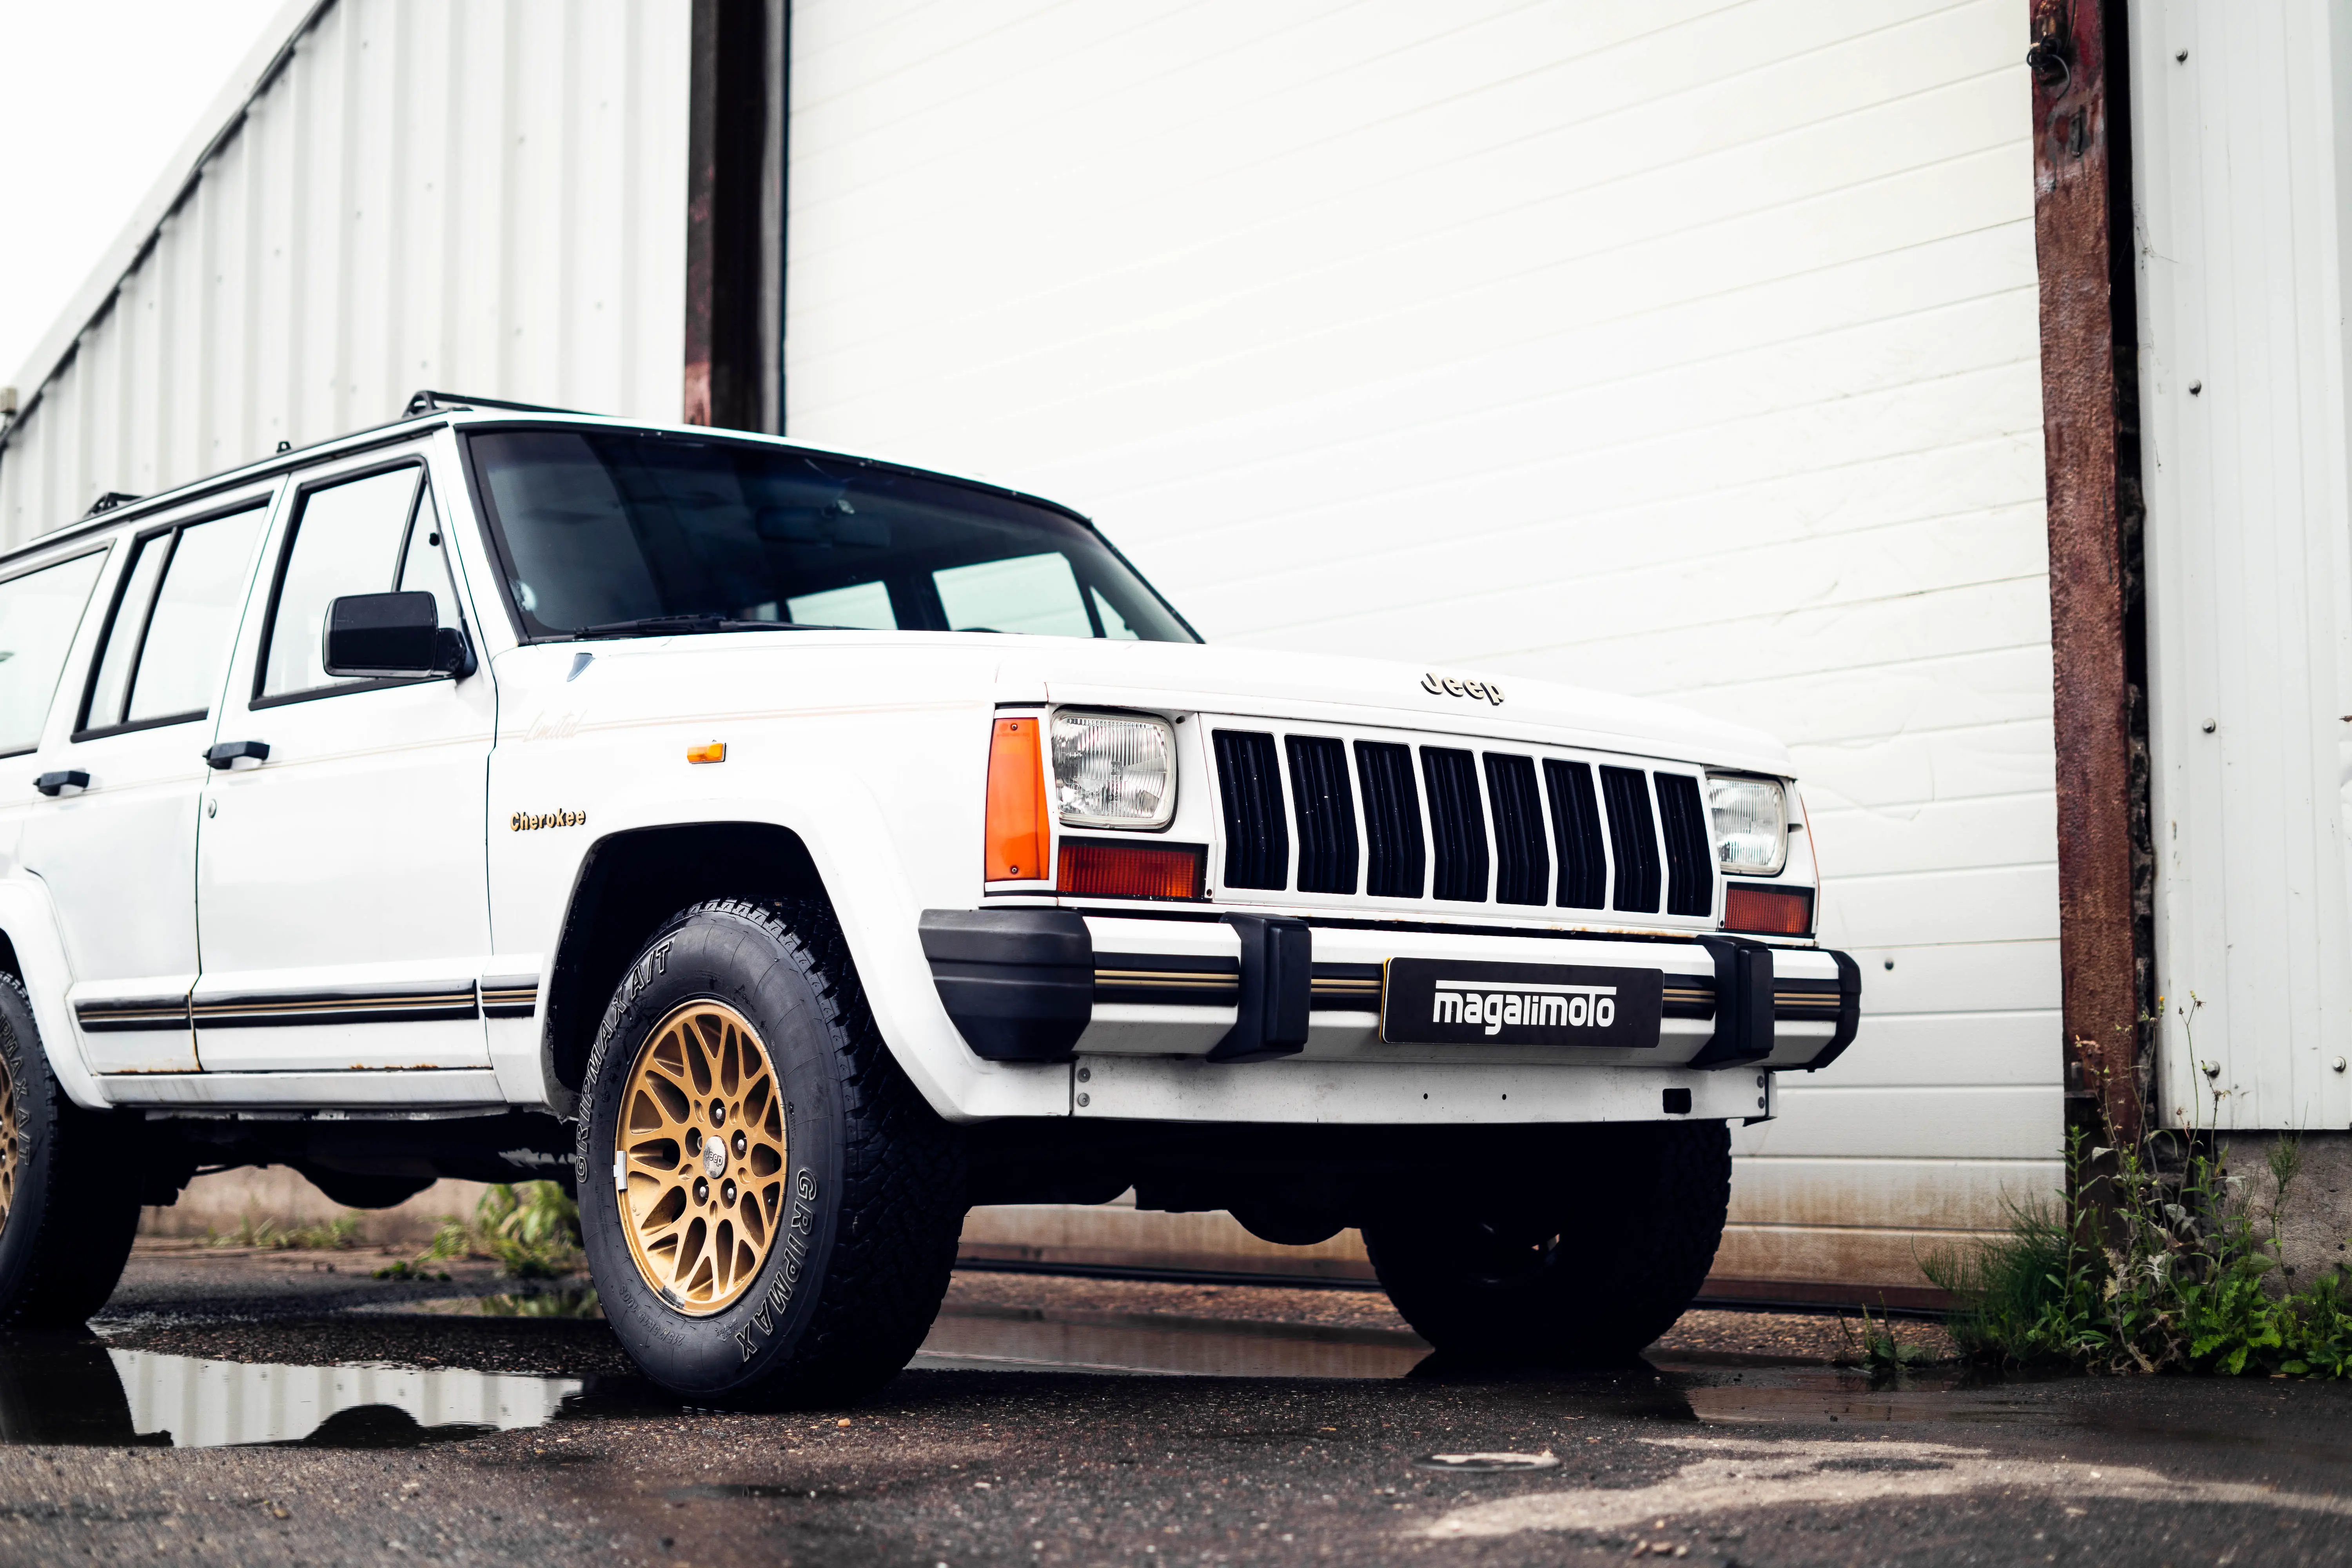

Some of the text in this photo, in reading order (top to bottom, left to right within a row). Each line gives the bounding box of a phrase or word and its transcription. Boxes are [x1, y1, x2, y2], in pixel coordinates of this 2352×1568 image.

[1420, 672, 1505, 706] Jeep
[523, 708, 588, 742] Limited
[1111, 764, 1121, 773] H4
[510, 808, 586, 831] Cherokee
[1433, 980, 1617, 1035] magalimoto
[575, 941, 673, 1183] GRIPMAX A/T
[18, 1106, 31, 1165] A/T
[704, 1147, 723, 1167] Jeep
[735, 1168, 817, 1363] GRIPMAX
